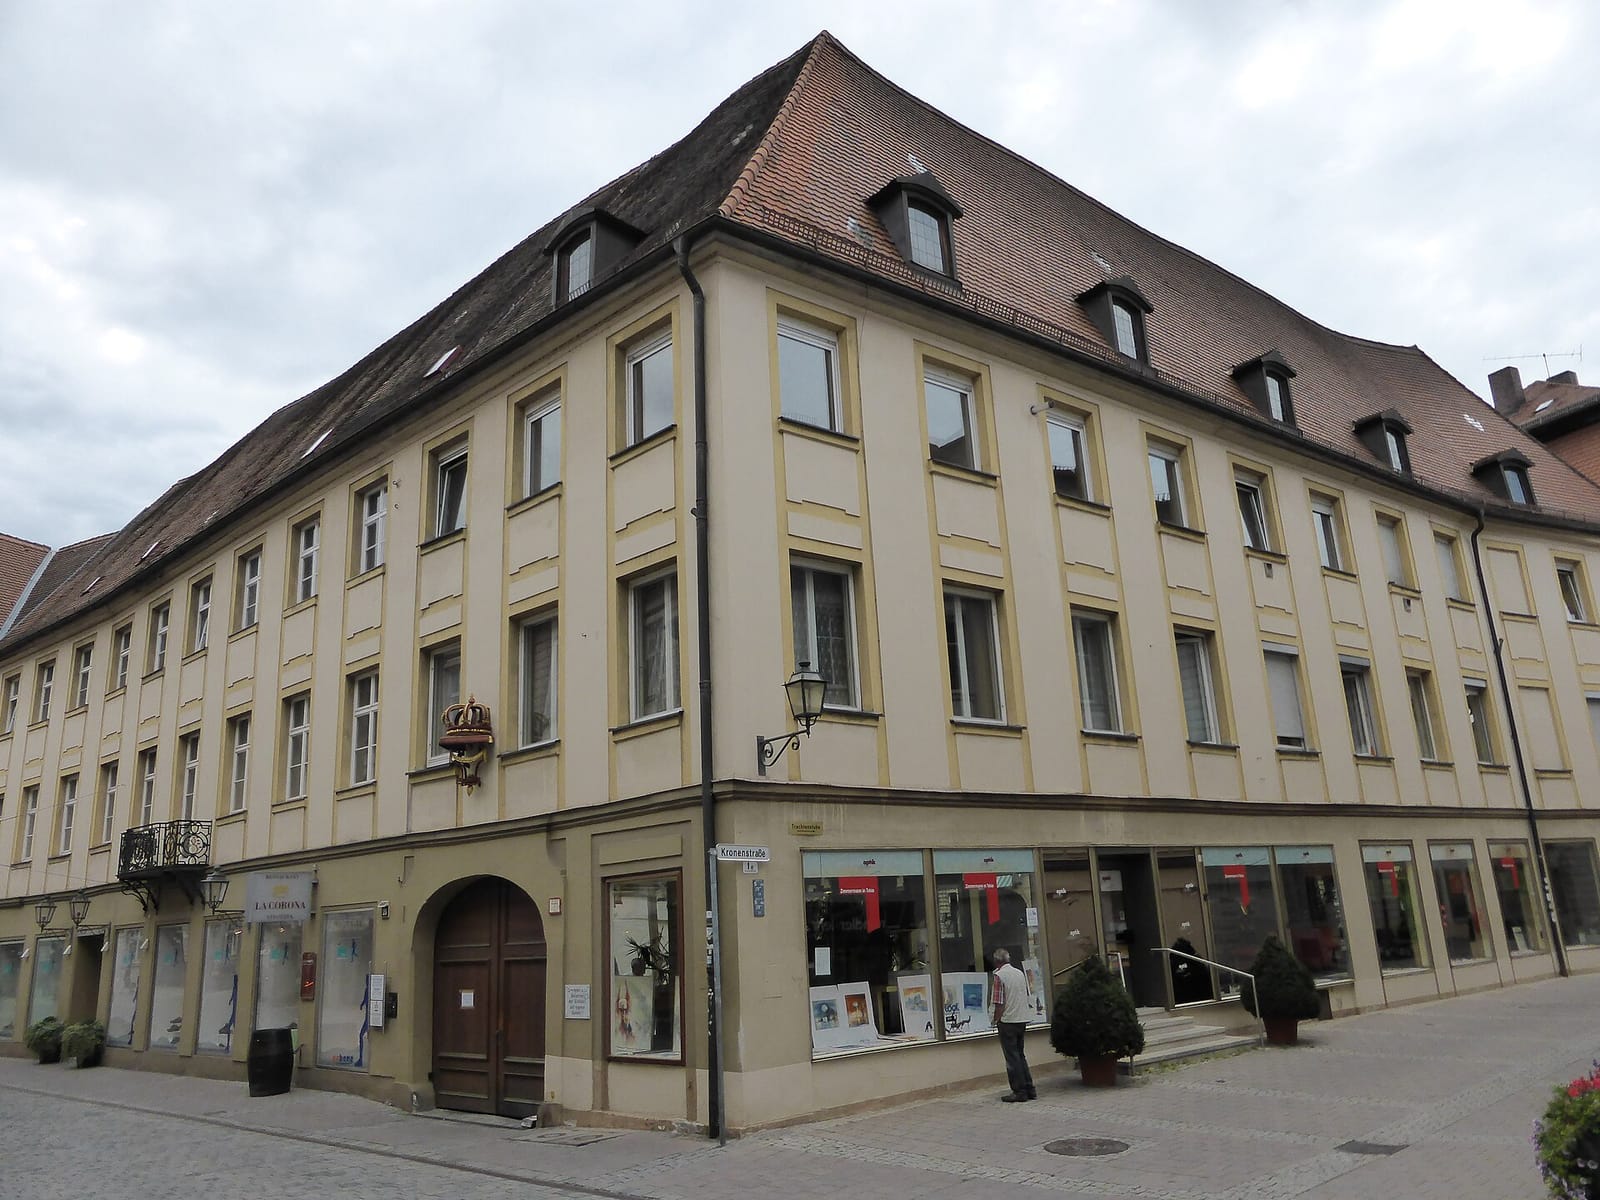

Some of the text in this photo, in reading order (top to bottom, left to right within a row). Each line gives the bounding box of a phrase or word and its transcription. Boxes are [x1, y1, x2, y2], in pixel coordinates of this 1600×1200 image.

[721, 847, 766, 858] Kronenstraße
[255, 901, 306, 910] LA CORONA
